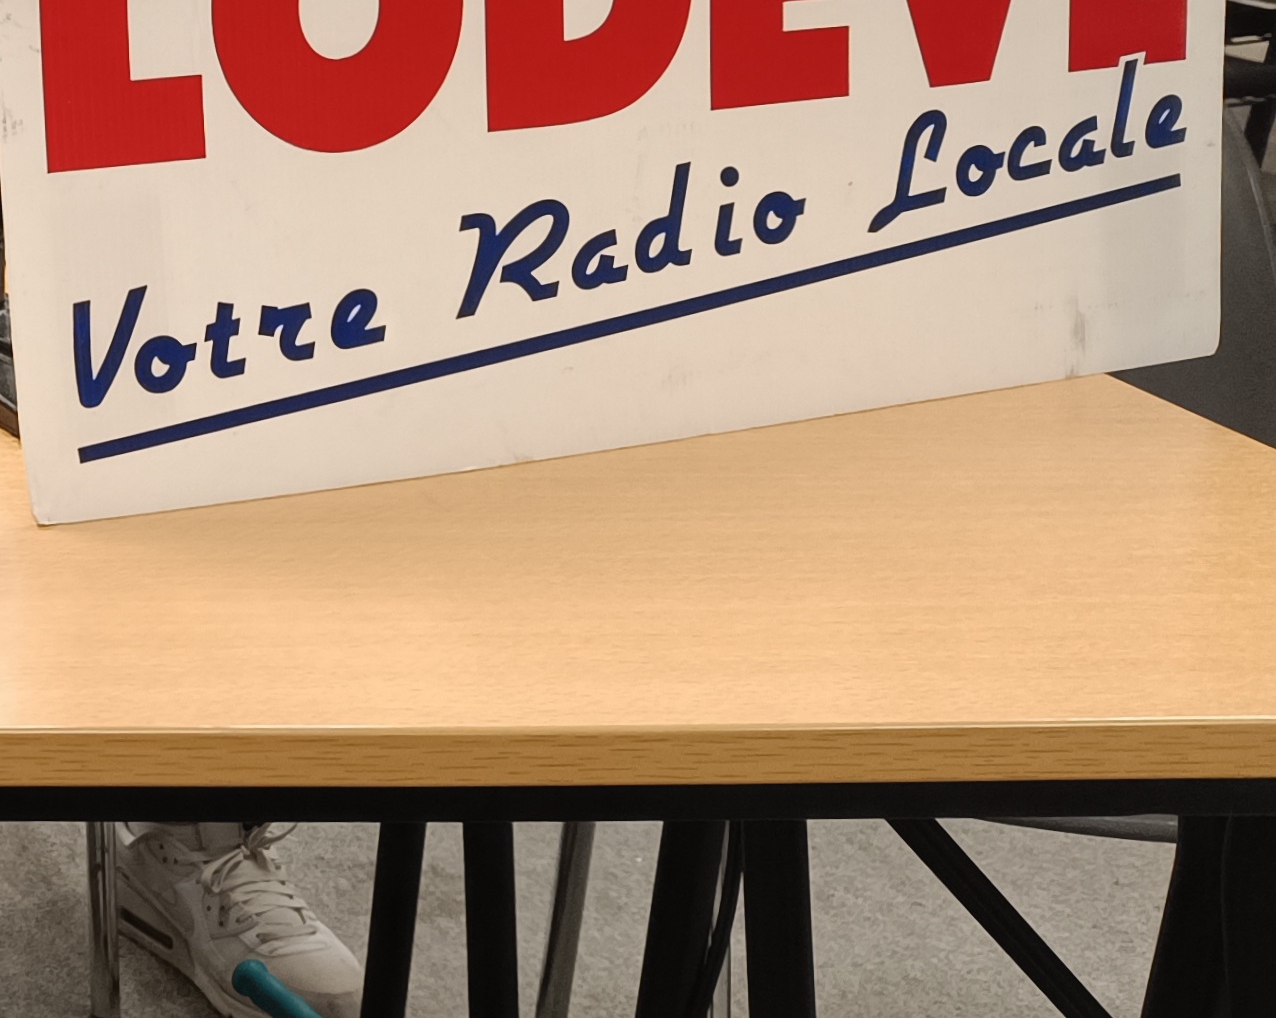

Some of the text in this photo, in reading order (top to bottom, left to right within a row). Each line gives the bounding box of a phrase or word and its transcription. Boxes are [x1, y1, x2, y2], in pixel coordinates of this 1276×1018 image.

[72, 60, 1189, 408] Votre Radio Locale
